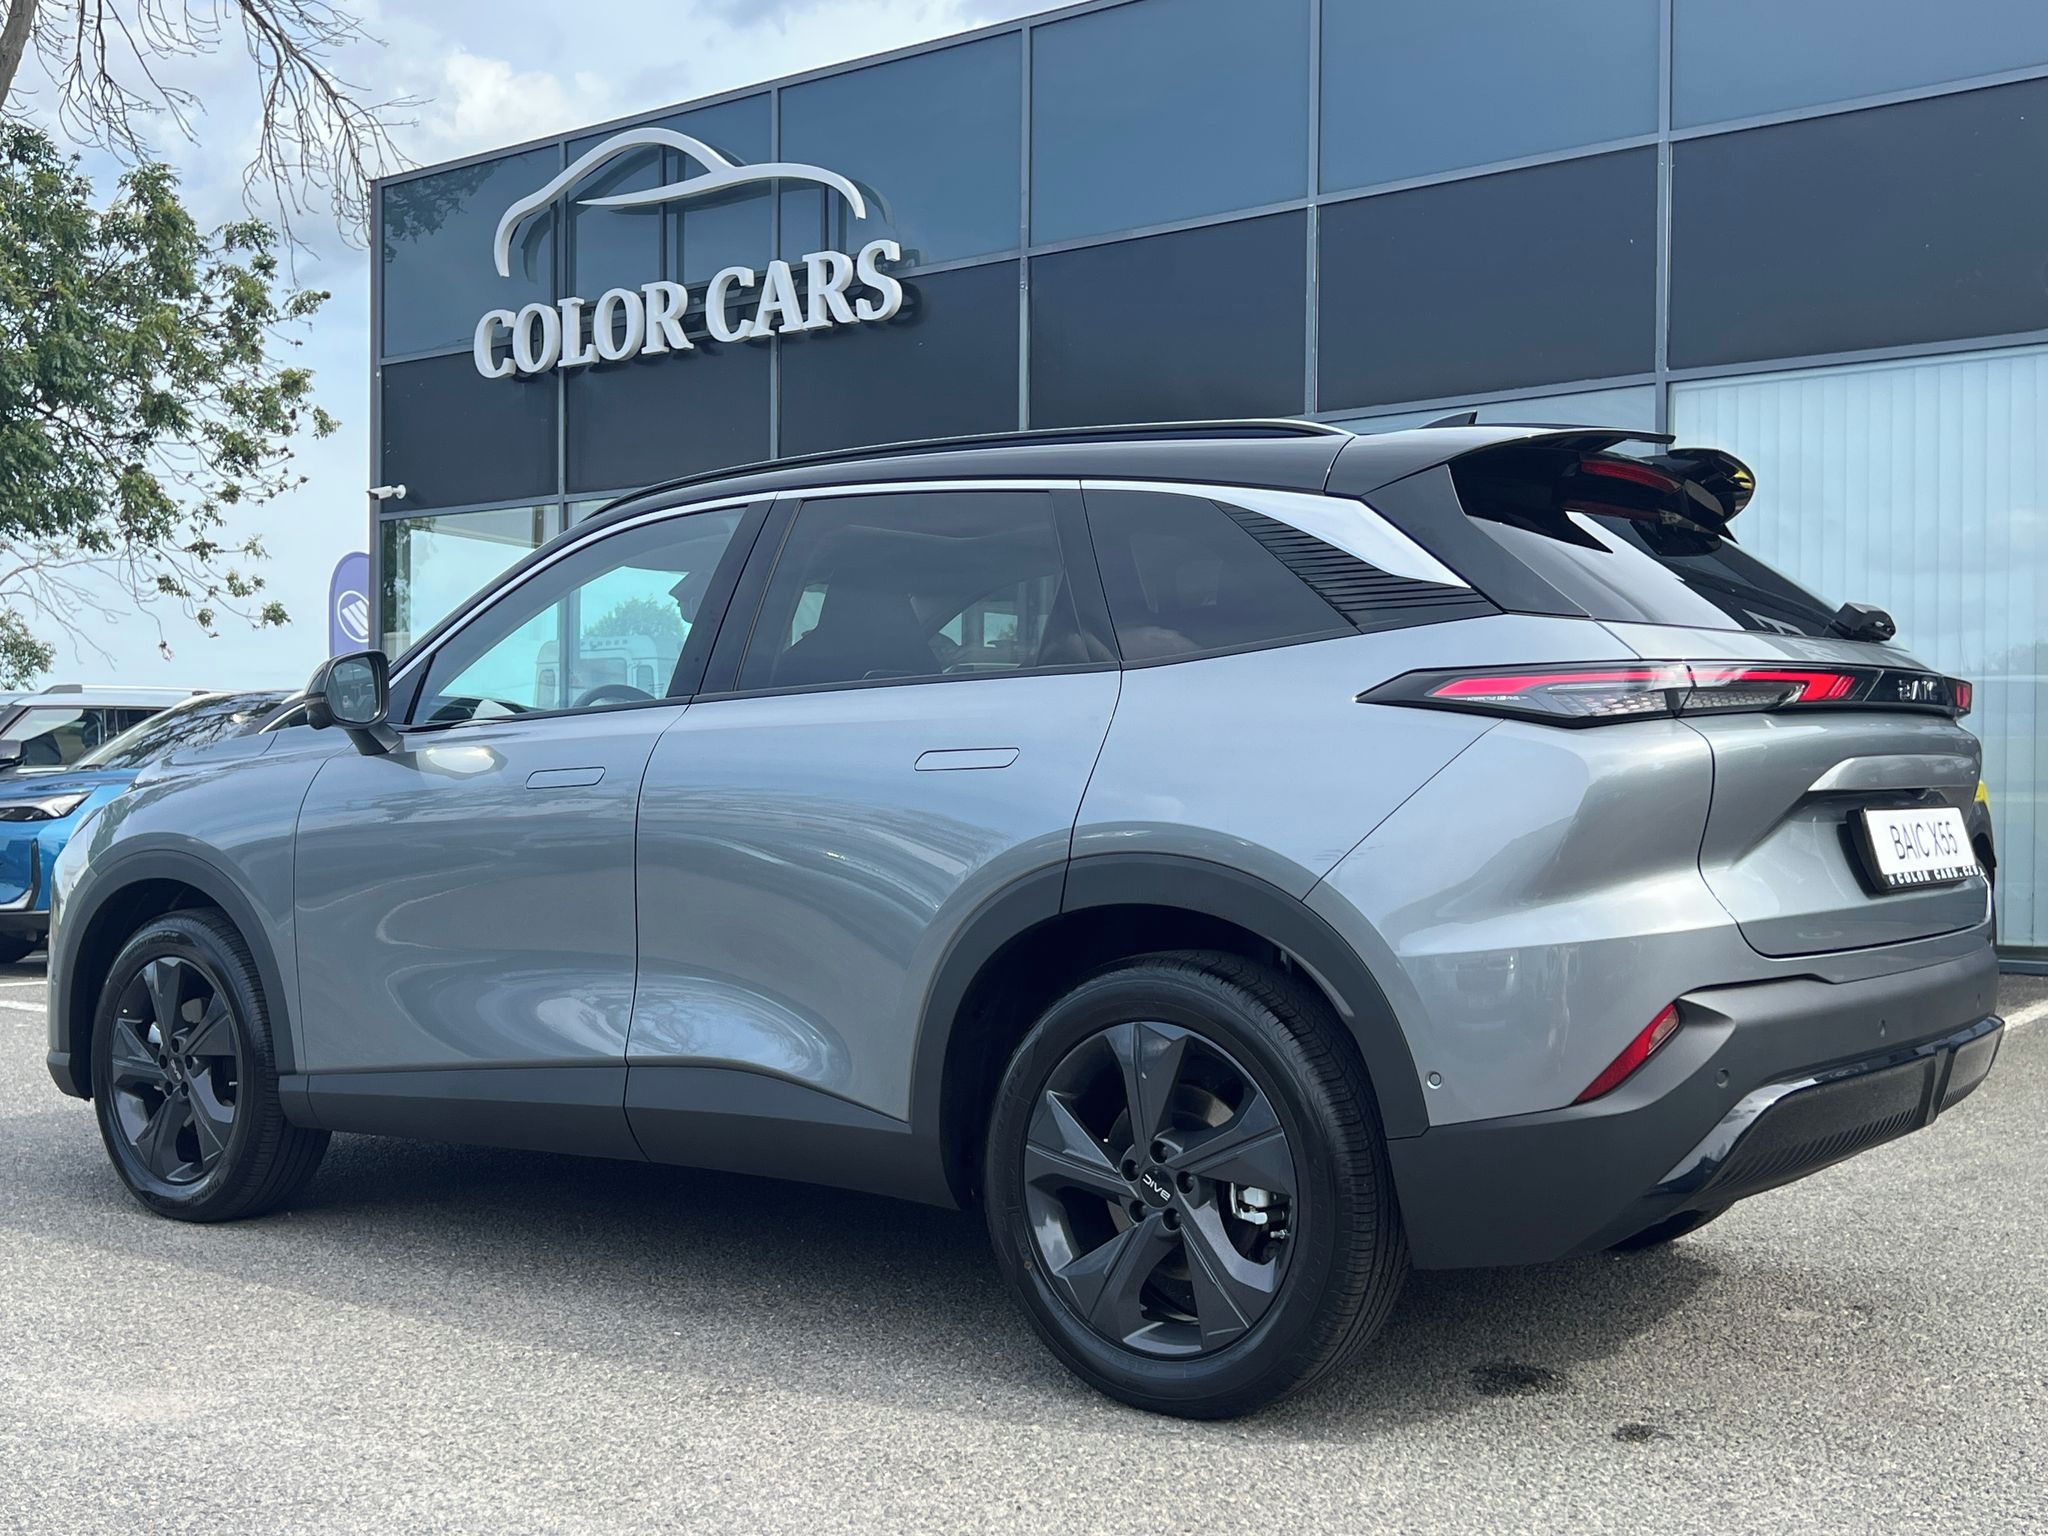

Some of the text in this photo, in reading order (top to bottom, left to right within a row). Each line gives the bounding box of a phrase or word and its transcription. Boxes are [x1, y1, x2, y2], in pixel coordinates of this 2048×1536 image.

[474, 239, 903, 379] COLOR CARS
[1889, 820, 1959, 860] BAIC X55
